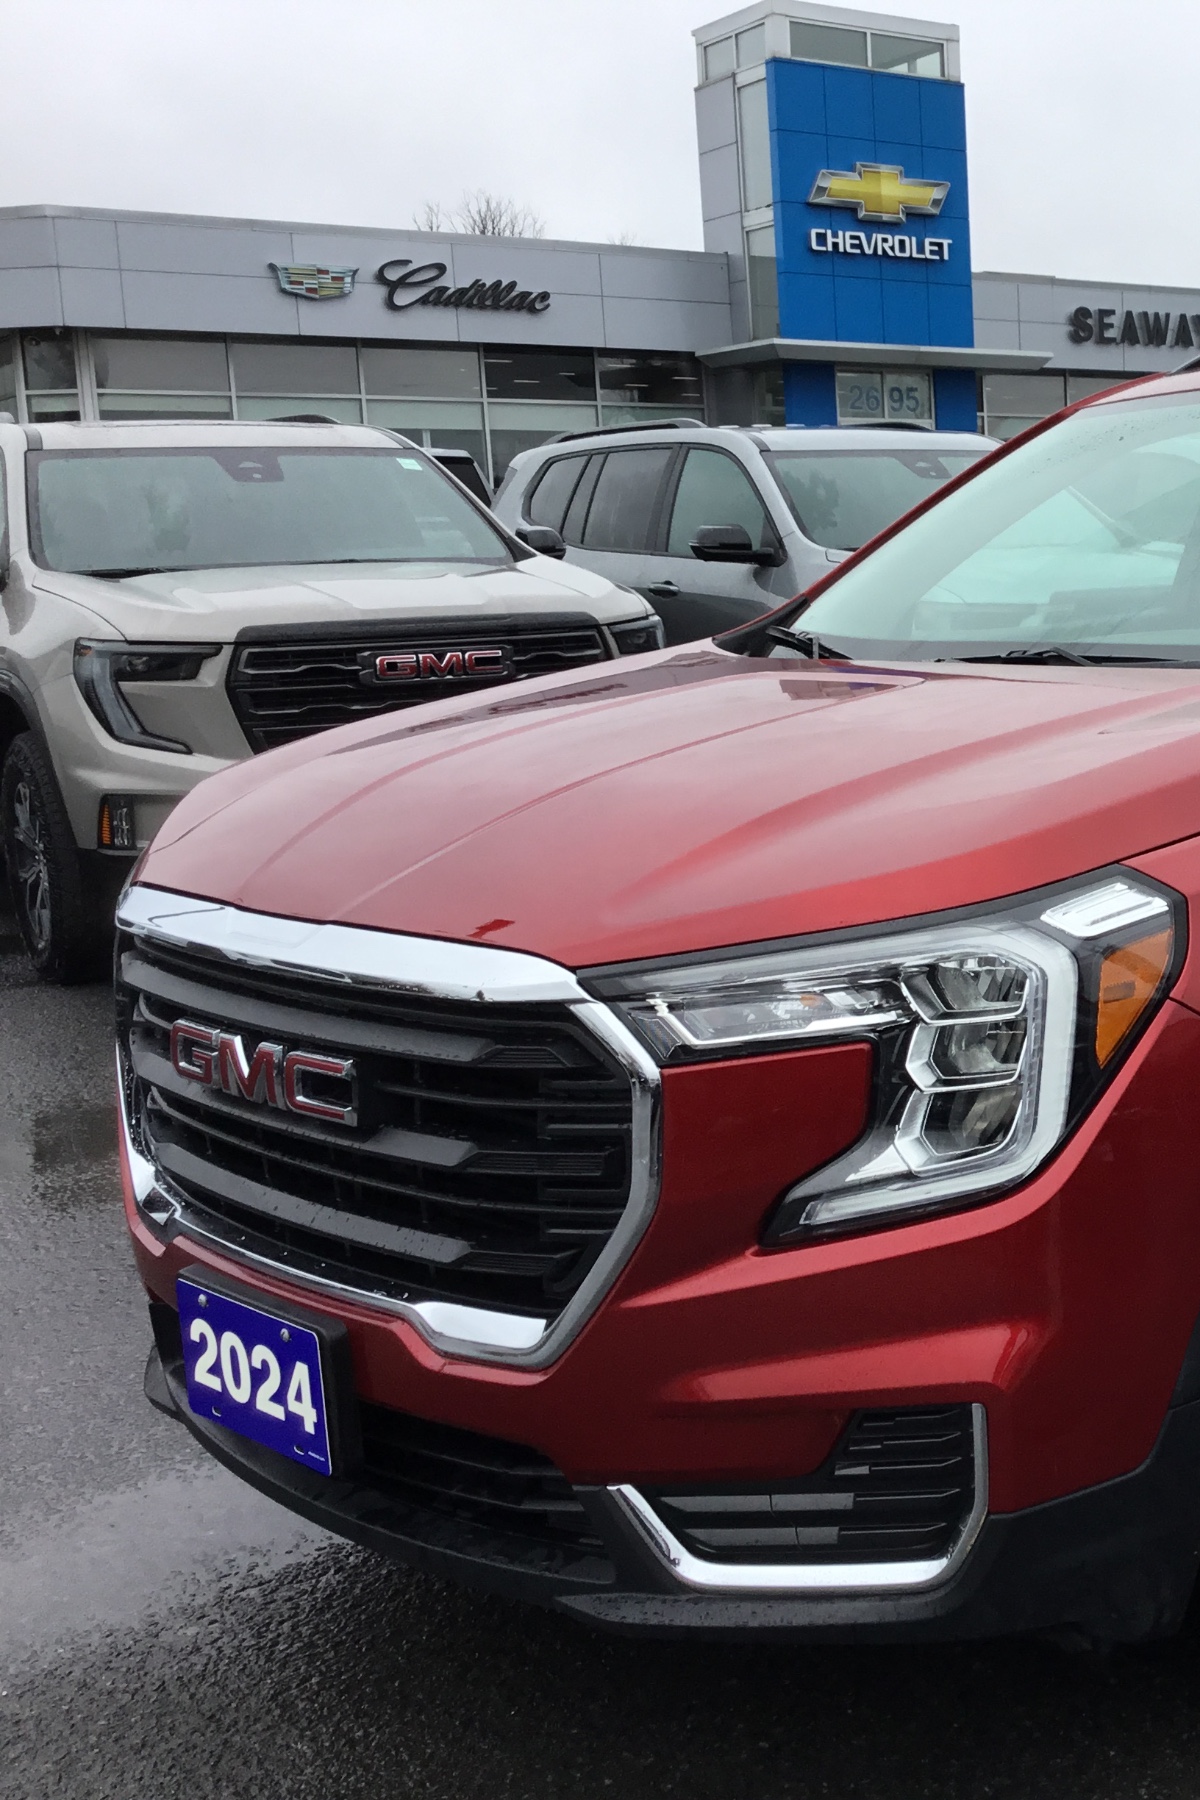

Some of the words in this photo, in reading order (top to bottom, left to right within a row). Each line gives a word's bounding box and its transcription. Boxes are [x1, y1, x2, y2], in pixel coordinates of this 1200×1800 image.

[810, 228, 953, 261] CHEVROLET
[376, 258, 551, 313] Cadillac
[375, 649, 504, 679] GMC
[170, 1017, 359, 1128] GMC
[189, 1317, 318, 1436] 2024
